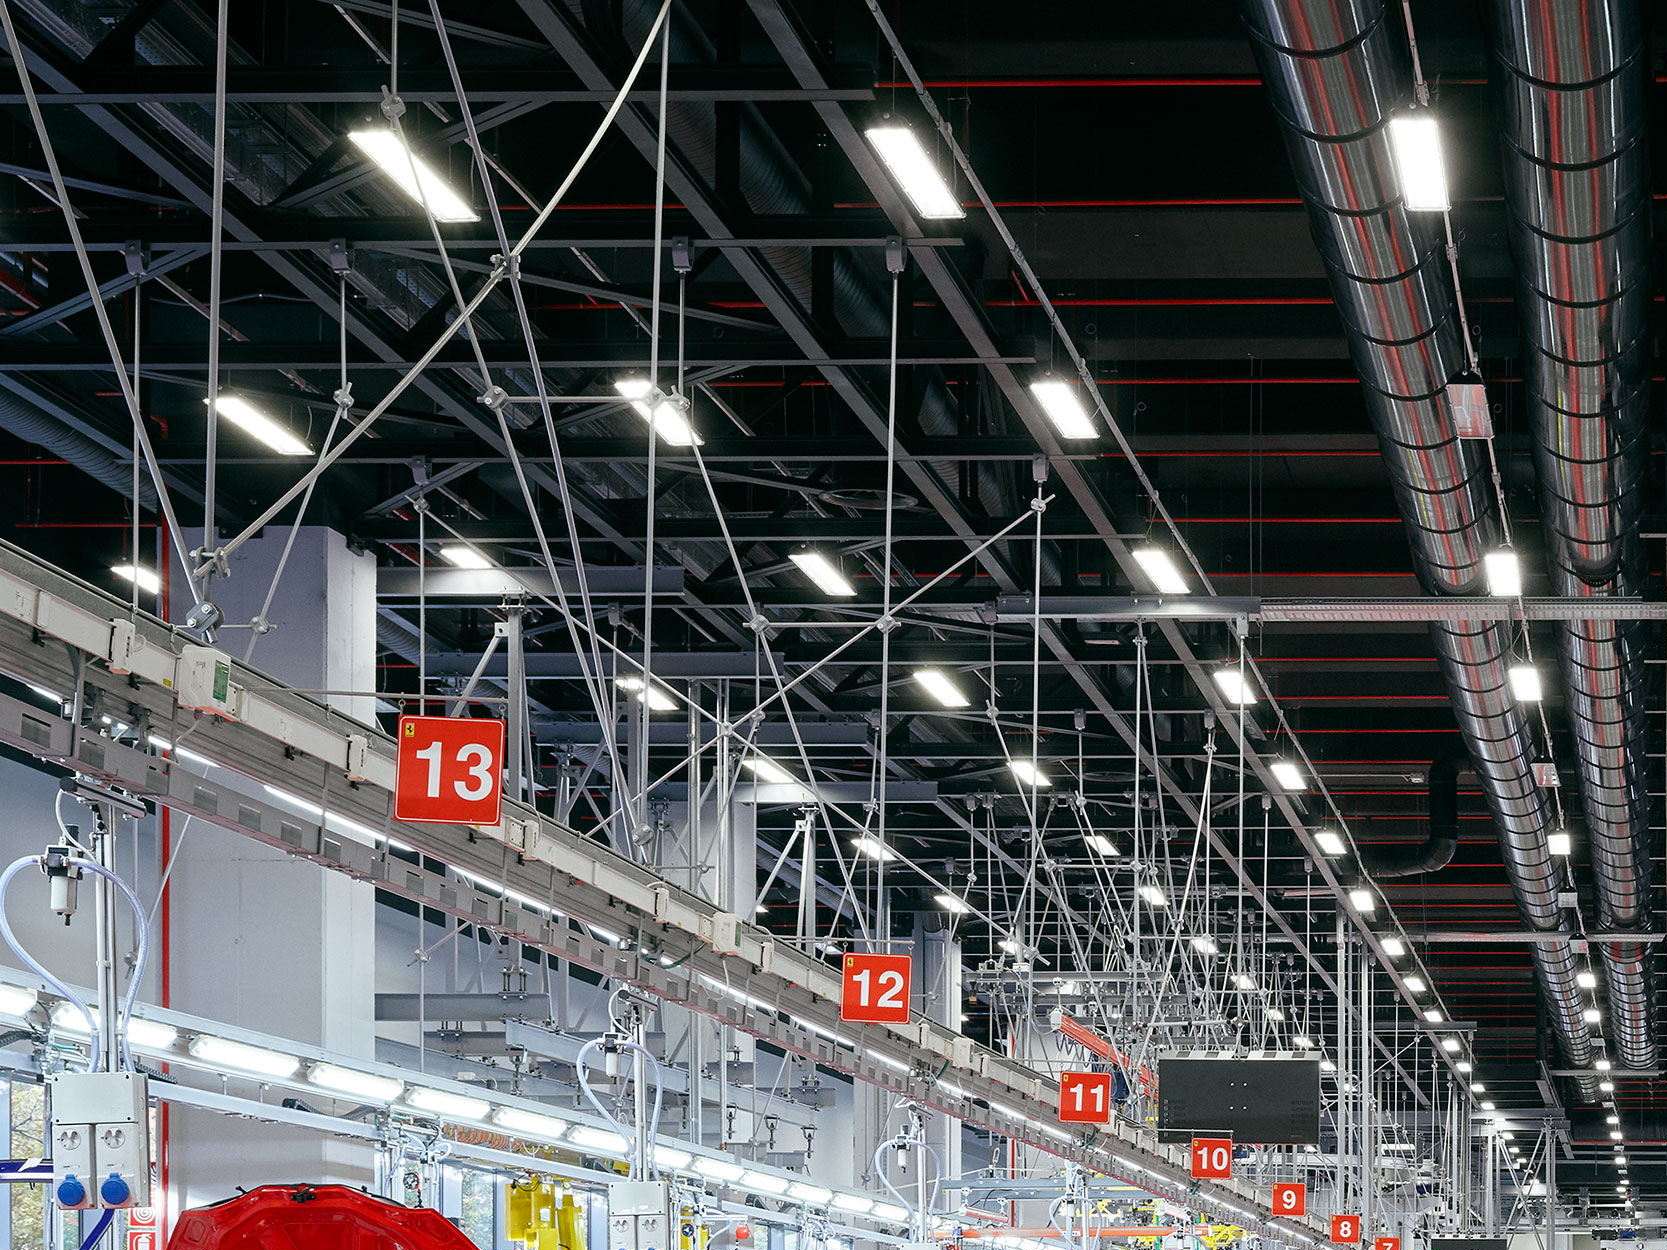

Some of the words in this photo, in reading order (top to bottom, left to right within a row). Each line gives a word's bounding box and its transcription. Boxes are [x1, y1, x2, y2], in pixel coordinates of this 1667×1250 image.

[415, 741, 495, 802] 13
[852, 968, 905, 1009] 12
[1069, 1083, 1104, 1113] 11
[1196, 1146, 1229, 1171] 10
[1282, 1189, 1297, 1210] 9
[1339, 1220, 1352, 1238] 8
